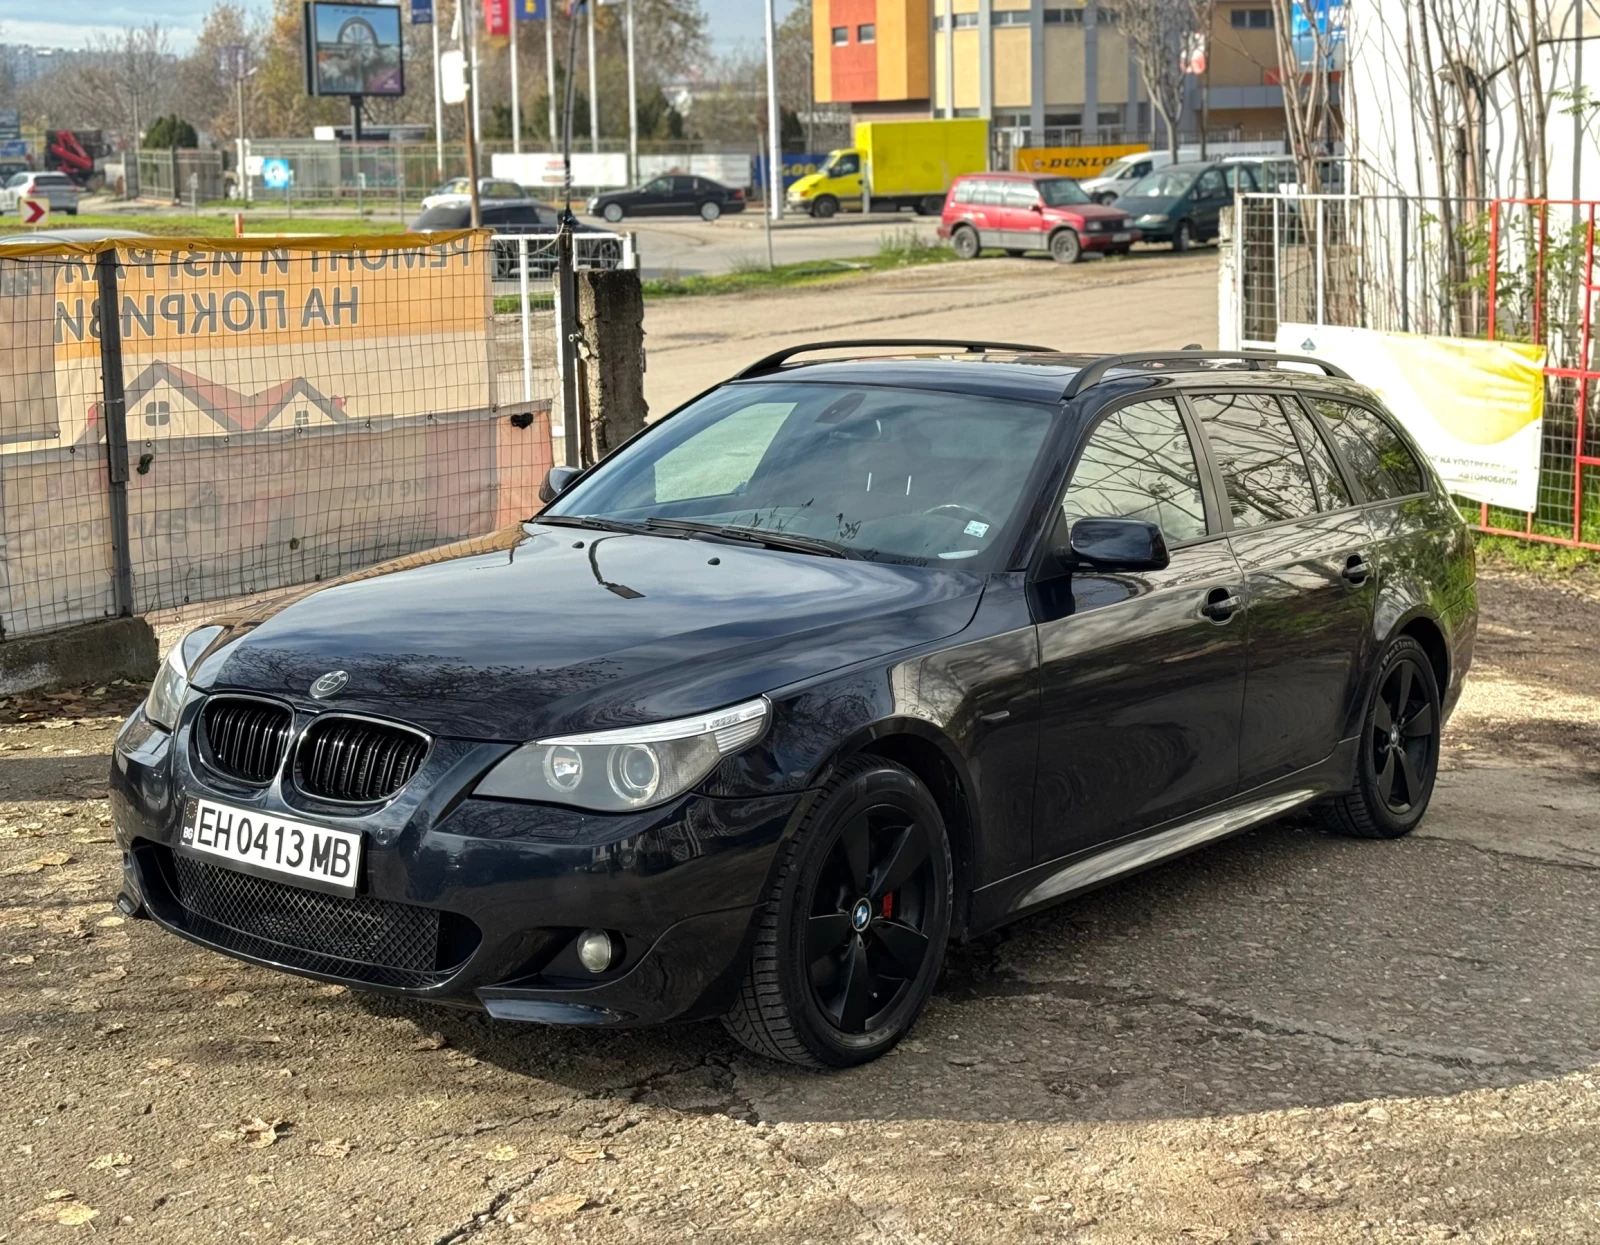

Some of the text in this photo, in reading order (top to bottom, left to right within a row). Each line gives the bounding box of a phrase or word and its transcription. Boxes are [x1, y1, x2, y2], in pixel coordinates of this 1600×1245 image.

[1458, 472, 1518, 486] АВТОМОБИЛИ
[183, 826, 194, 840] BG
[197, 806, 351, 878] EH 0413 MB
